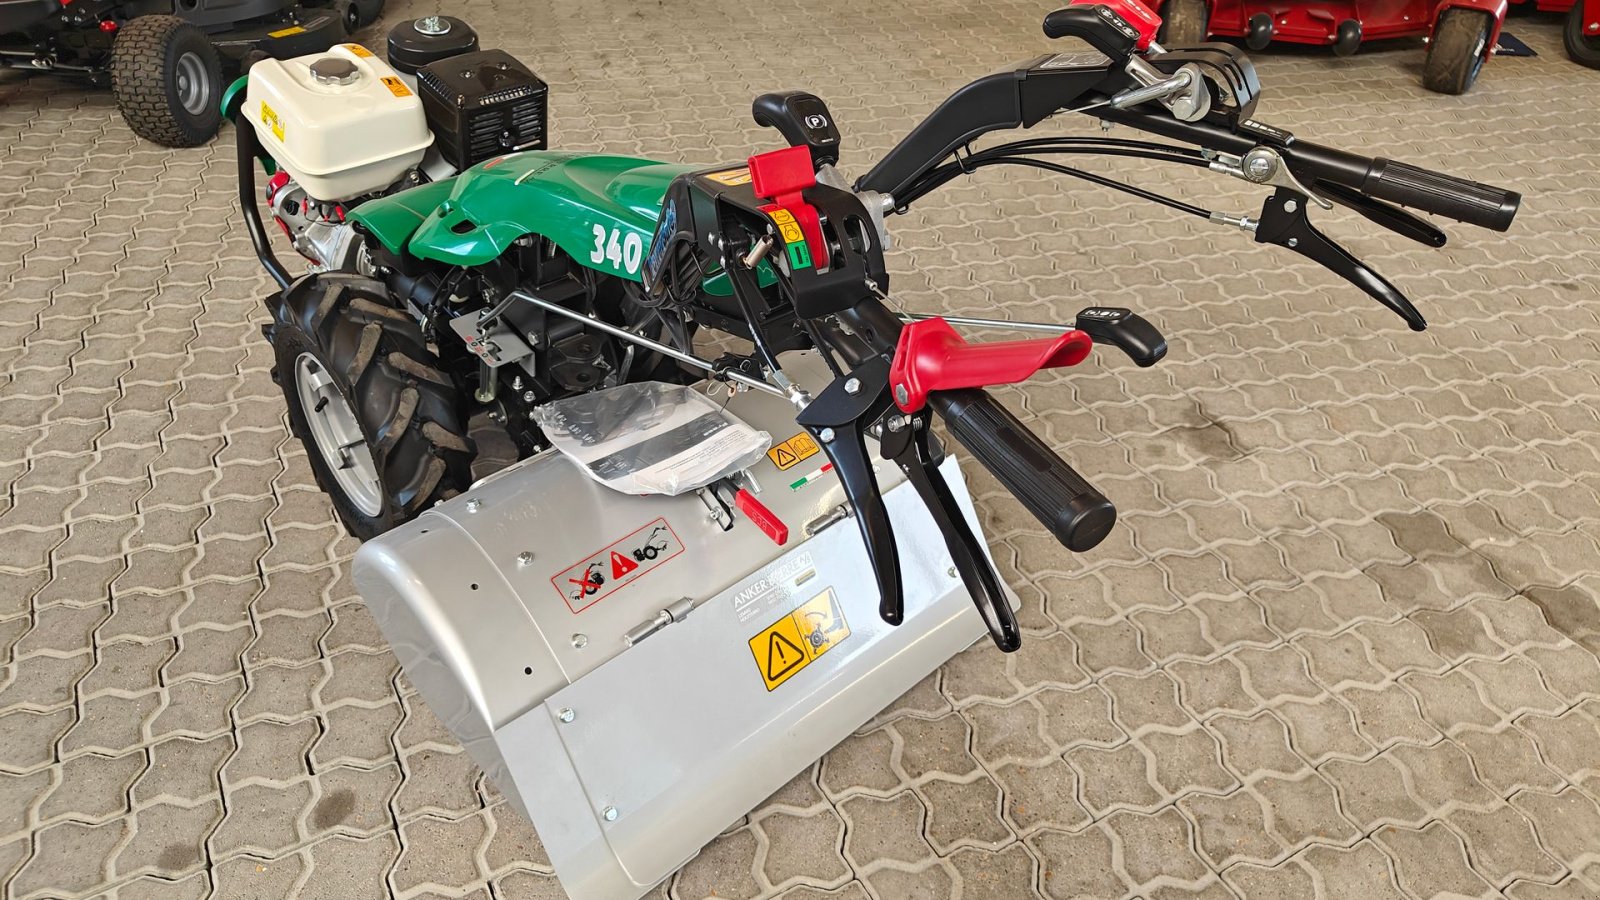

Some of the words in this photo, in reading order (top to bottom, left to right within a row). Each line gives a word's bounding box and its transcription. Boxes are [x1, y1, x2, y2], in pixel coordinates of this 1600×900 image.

[811, 117, 819, 126] P
[591, 223, 643, 275] 340
[734, 579, 768, 608] ANKER
